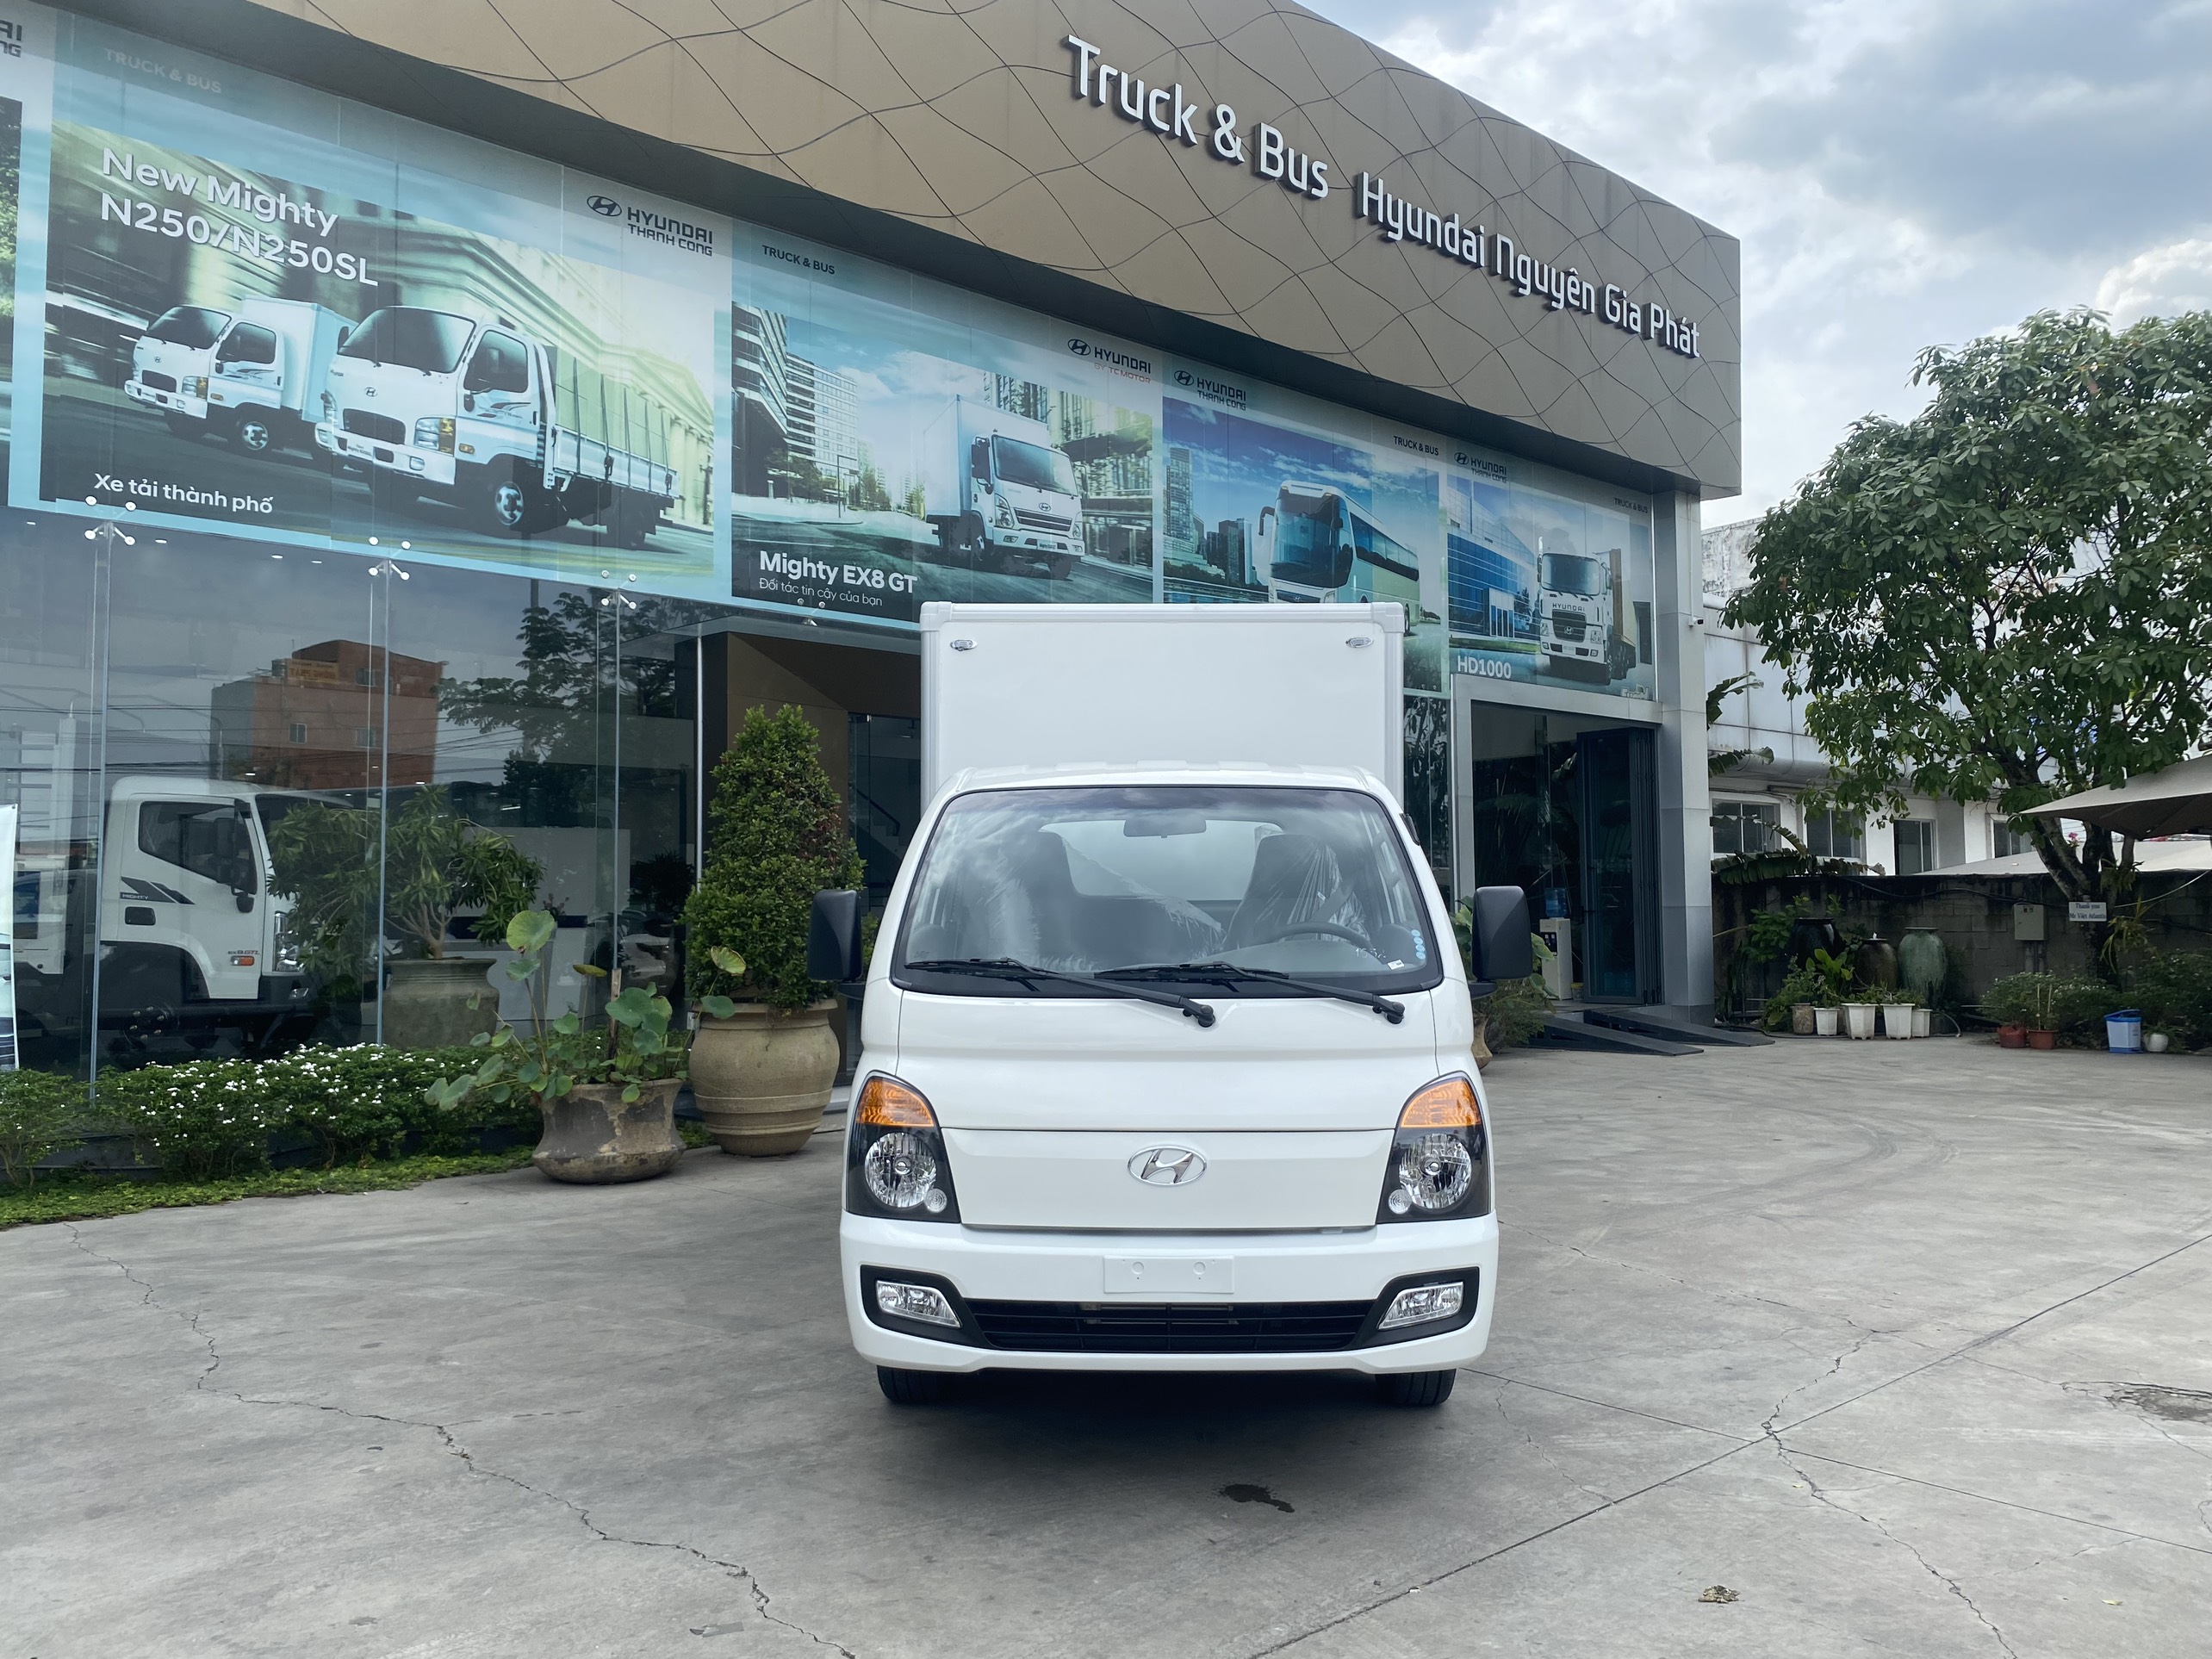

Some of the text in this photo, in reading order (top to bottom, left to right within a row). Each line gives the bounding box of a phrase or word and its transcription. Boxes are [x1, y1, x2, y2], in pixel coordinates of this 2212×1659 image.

[103, 47, 222, 94] TRUCK & BUS
[1062, 34, 1329, 199] Truck & Bus
[103, 147, 339, 237] New Mighty
[100, 192, 379, 287] N250/N250SL
[627, 206, 713, 245] HYUNDAI
[627, 222, 713, 257] THANH CONG
[762, 244, 836, 275] TRUCK & BUS
[1358, 171, 1700, 358] Hyundai Nguyên Gia Phát
[1094, 346, 1152, 374] HYUNDAI
[1120, 371, 1152, 385] MOTOR
[1196, 376, 1246, 401] HYUNDAI
[1196, 389, 1246, 412] THANH CONG
[1393, 435, 1439, 457] TRUCK & BUS
[1470, 457, 1507, 475] HYUNDAI
[94, 473, 274, 514] Xe tải thành phố
[1613, 497, 1632, 509] TRUCK
[760, 550, 918, 593] Mighty EX8 GT
[759, 577, 883, 607] Đối tác tin cậy của bạn
[1552, 602, 1585, 612] HYUNDAI
[1457, 655, 1512, 680] HD1000
